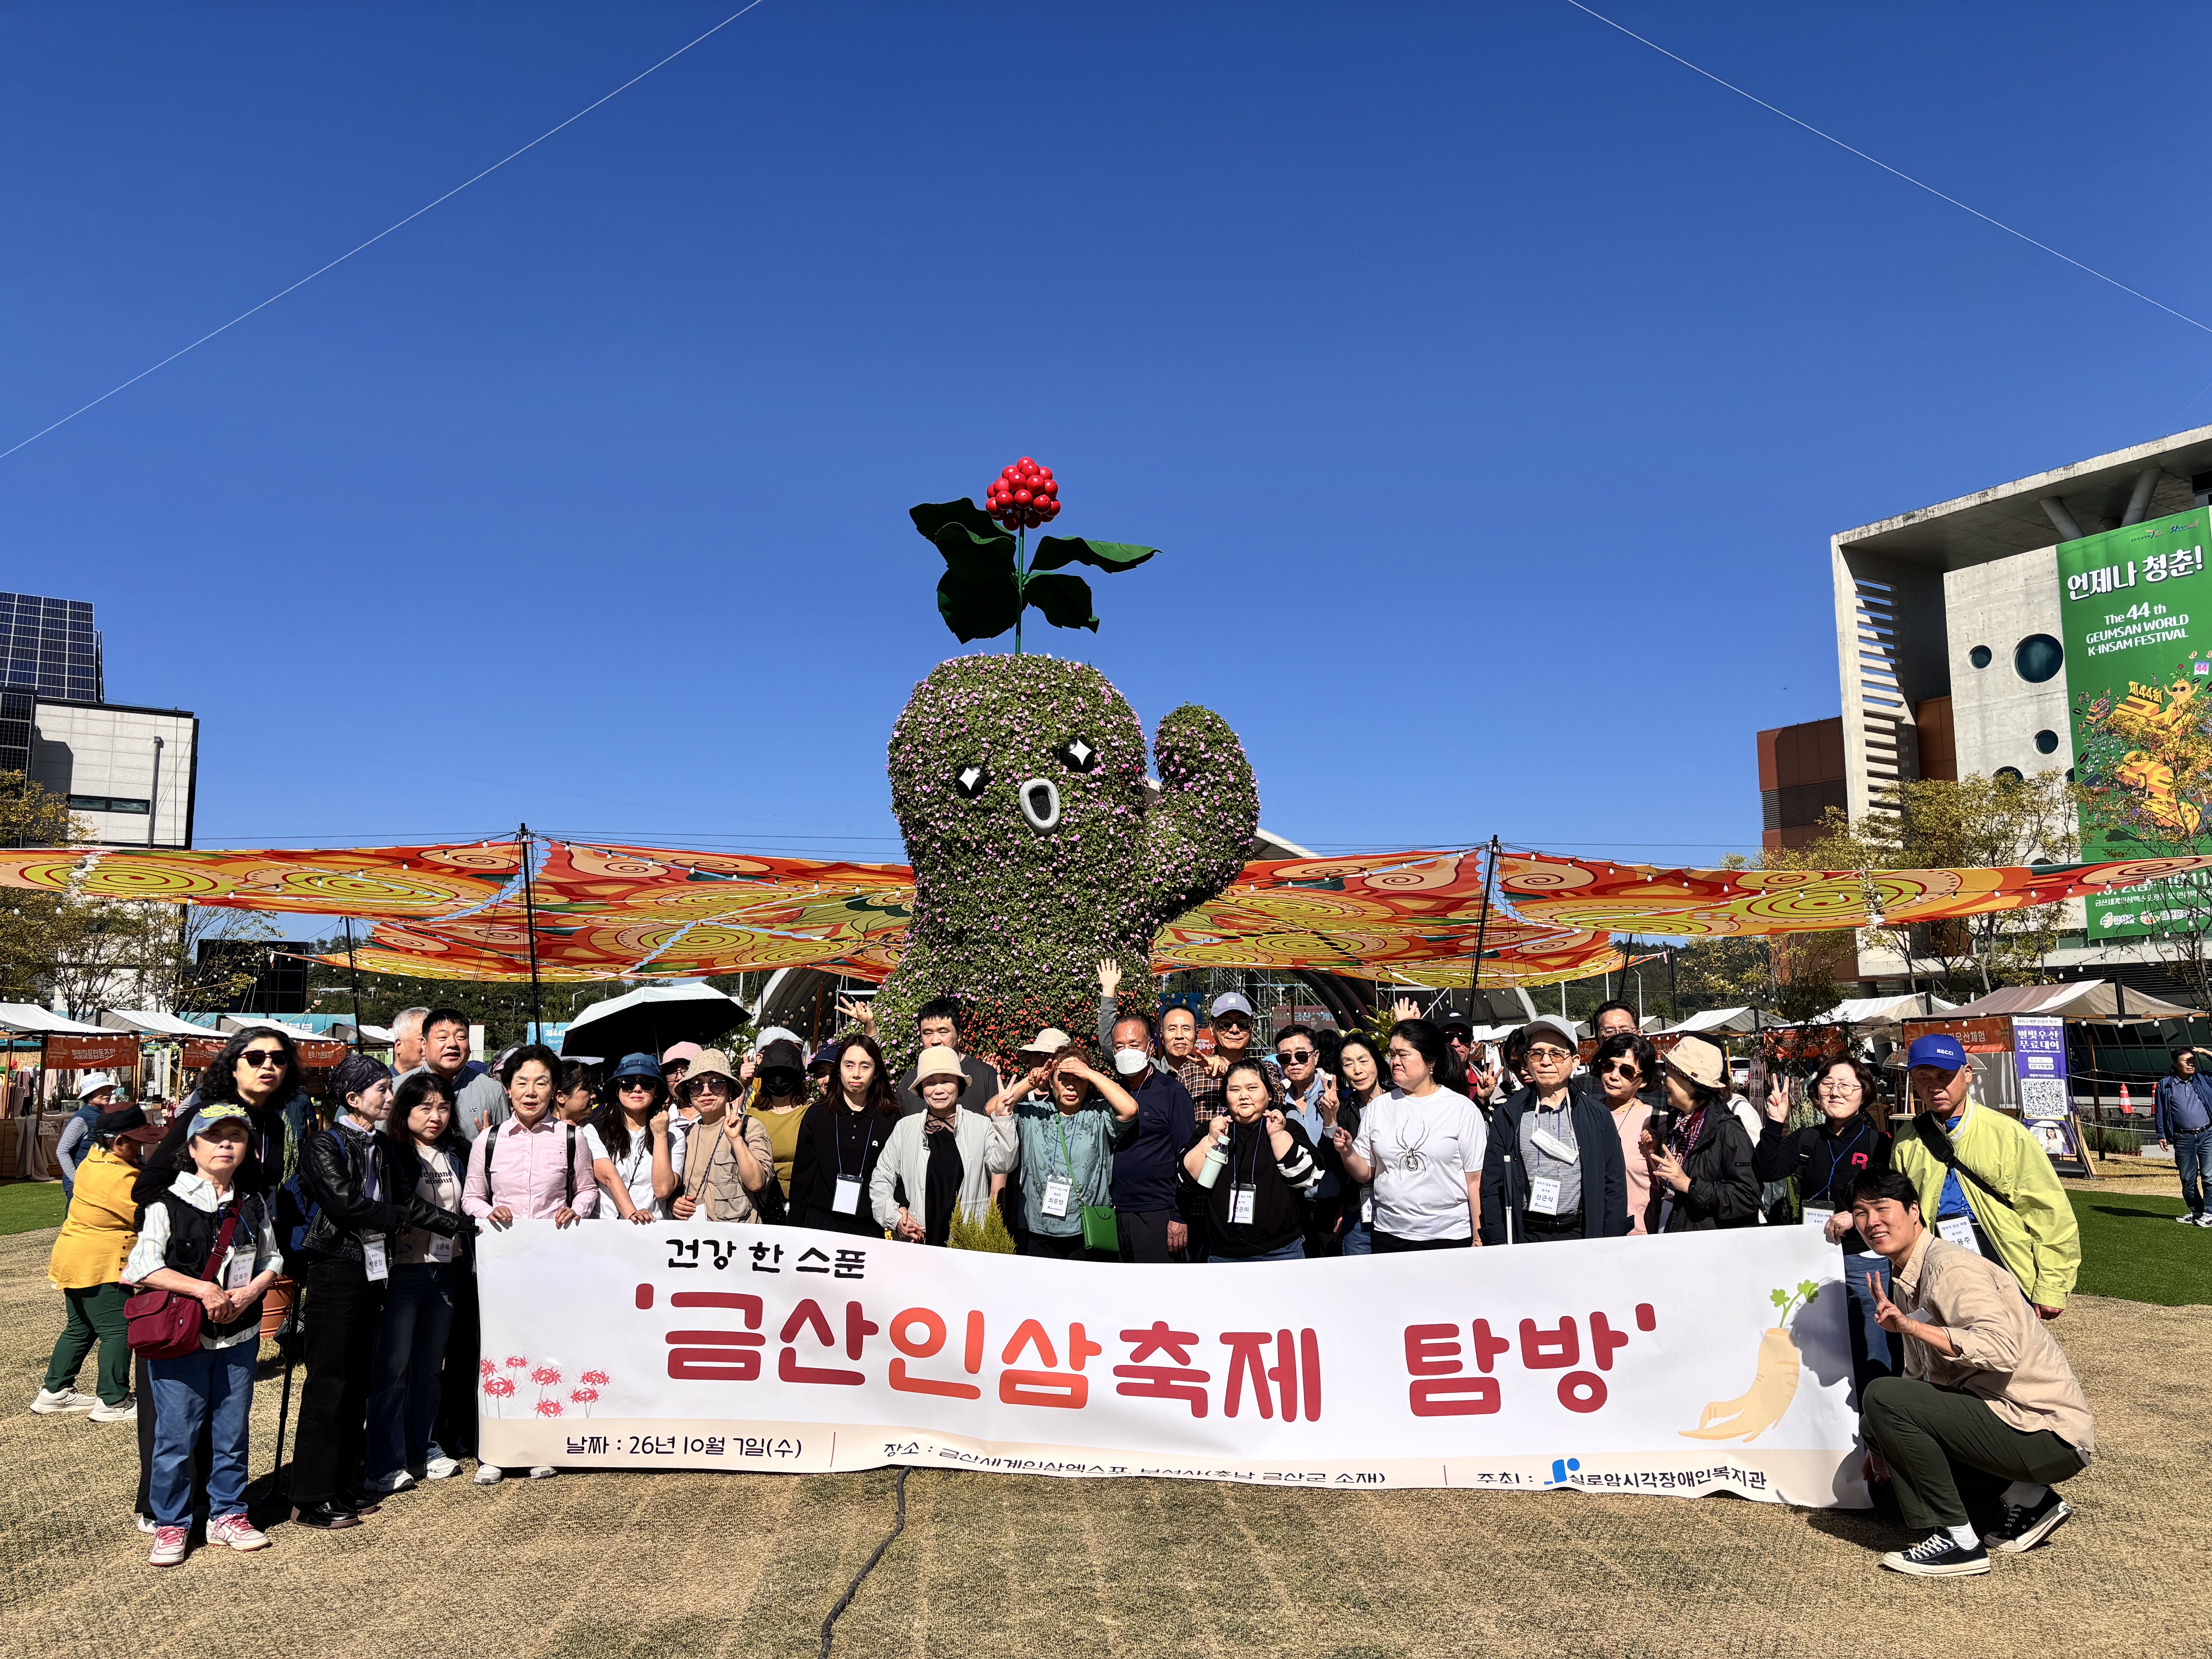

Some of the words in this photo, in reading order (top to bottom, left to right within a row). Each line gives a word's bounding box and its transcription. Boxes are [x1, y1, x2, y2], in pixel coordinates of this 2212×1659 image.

[2067, 560, 2137, 601] 언제나
[2142, 545, 2203, 582] 청춘!
[2104, 613, 2125, 625] The
[2126, 602, 2151, 620] 44
[2153, 604, 2167, 615] th
[2086, 623, 2142, 644] GEUMSAN
[2143, 614, 2189, 633] WORLD
[2088, 640, 2133, 657] K-INSAM
[2134, 628, 2190, 647] FESTIVAL
[2128, 681, 2164, 703] 제44회
[2113, 914, 2135, 926] 금산군
[429, 1170, 453, 1179] grand
[1536, 1194, 1553, 1203] 신근식
[665, 1238, 737, 1271] 건강
[748, 1242, 784, 1274] 한
[795, 1246, 866, 1279] 스푼
[1404, 1303, 1657, 1417] 탐방'
[567, 1436, 610, 1455] 날짜
[617, 1439, 621, 1451] :
[629, 1436, 676, 1455] 26년
[684, 1436, 725, 1456] 10월
[733, 1437, 802, 1459] 7일(수)
[884, 1442, 919, 1458] 장소
[1262, 1472, 1326, 1483] 금산군
[1334, 1472, 1385, 1484] 소재)
[1477, 1472, 1520, 1484] 주최
[1568, 1465, 1767, 1491] 실로암시각장애인복지관
